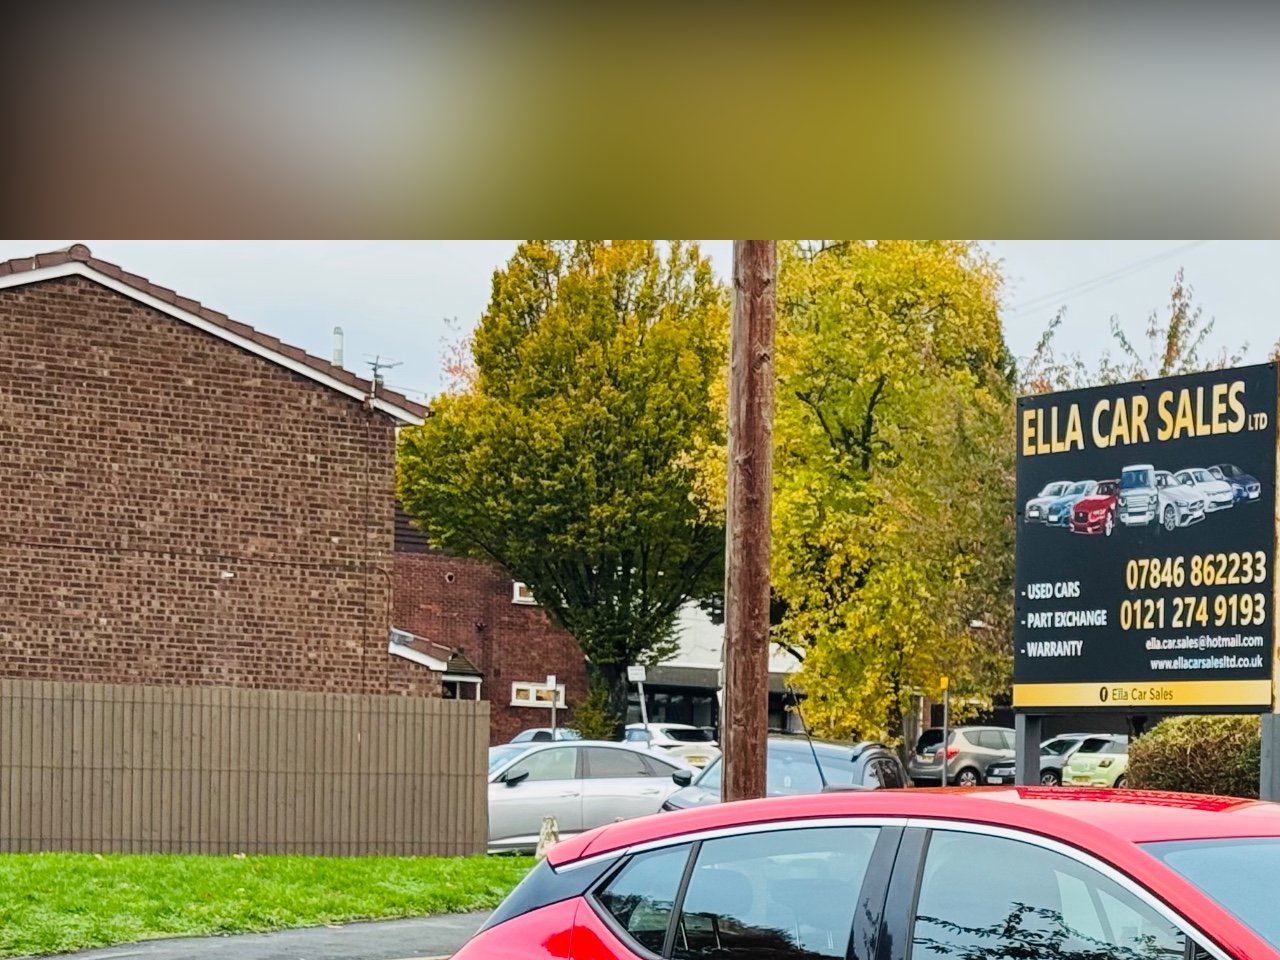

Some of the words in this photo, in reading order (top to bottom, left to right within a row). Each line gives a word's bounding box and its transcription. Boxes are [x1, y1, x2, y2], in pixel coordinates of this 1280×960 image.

[1023, 404, 1084, 456] ELLA
[1092, 395, 1149, 449] CAR
[1157, 381, 1245, 441] SALES
[1248, 412, 1268, 431] LTD
[1126, 556, 1185, 591] 07846
[1190, 550, 1267, 587] 862233
[1027, 583, 1053, 599] USED
[1054, 581, 1080, 598] CARS
[1027, 612, 1053, 628] PART
[1054, 609, 1107, 627] EXCHANGE
[1120, 598, 1165, 630] 0121
[1171, 596, 1209, 628] 274
[1214, 592, 1266, 626] 9193
[1027, 640, 1083, 657] WARRANTY
[1112, 688, 1129, 701] Ella
[1131, 688, 1147, 701] Car
[1149, 687, 1174, 701] Sales
